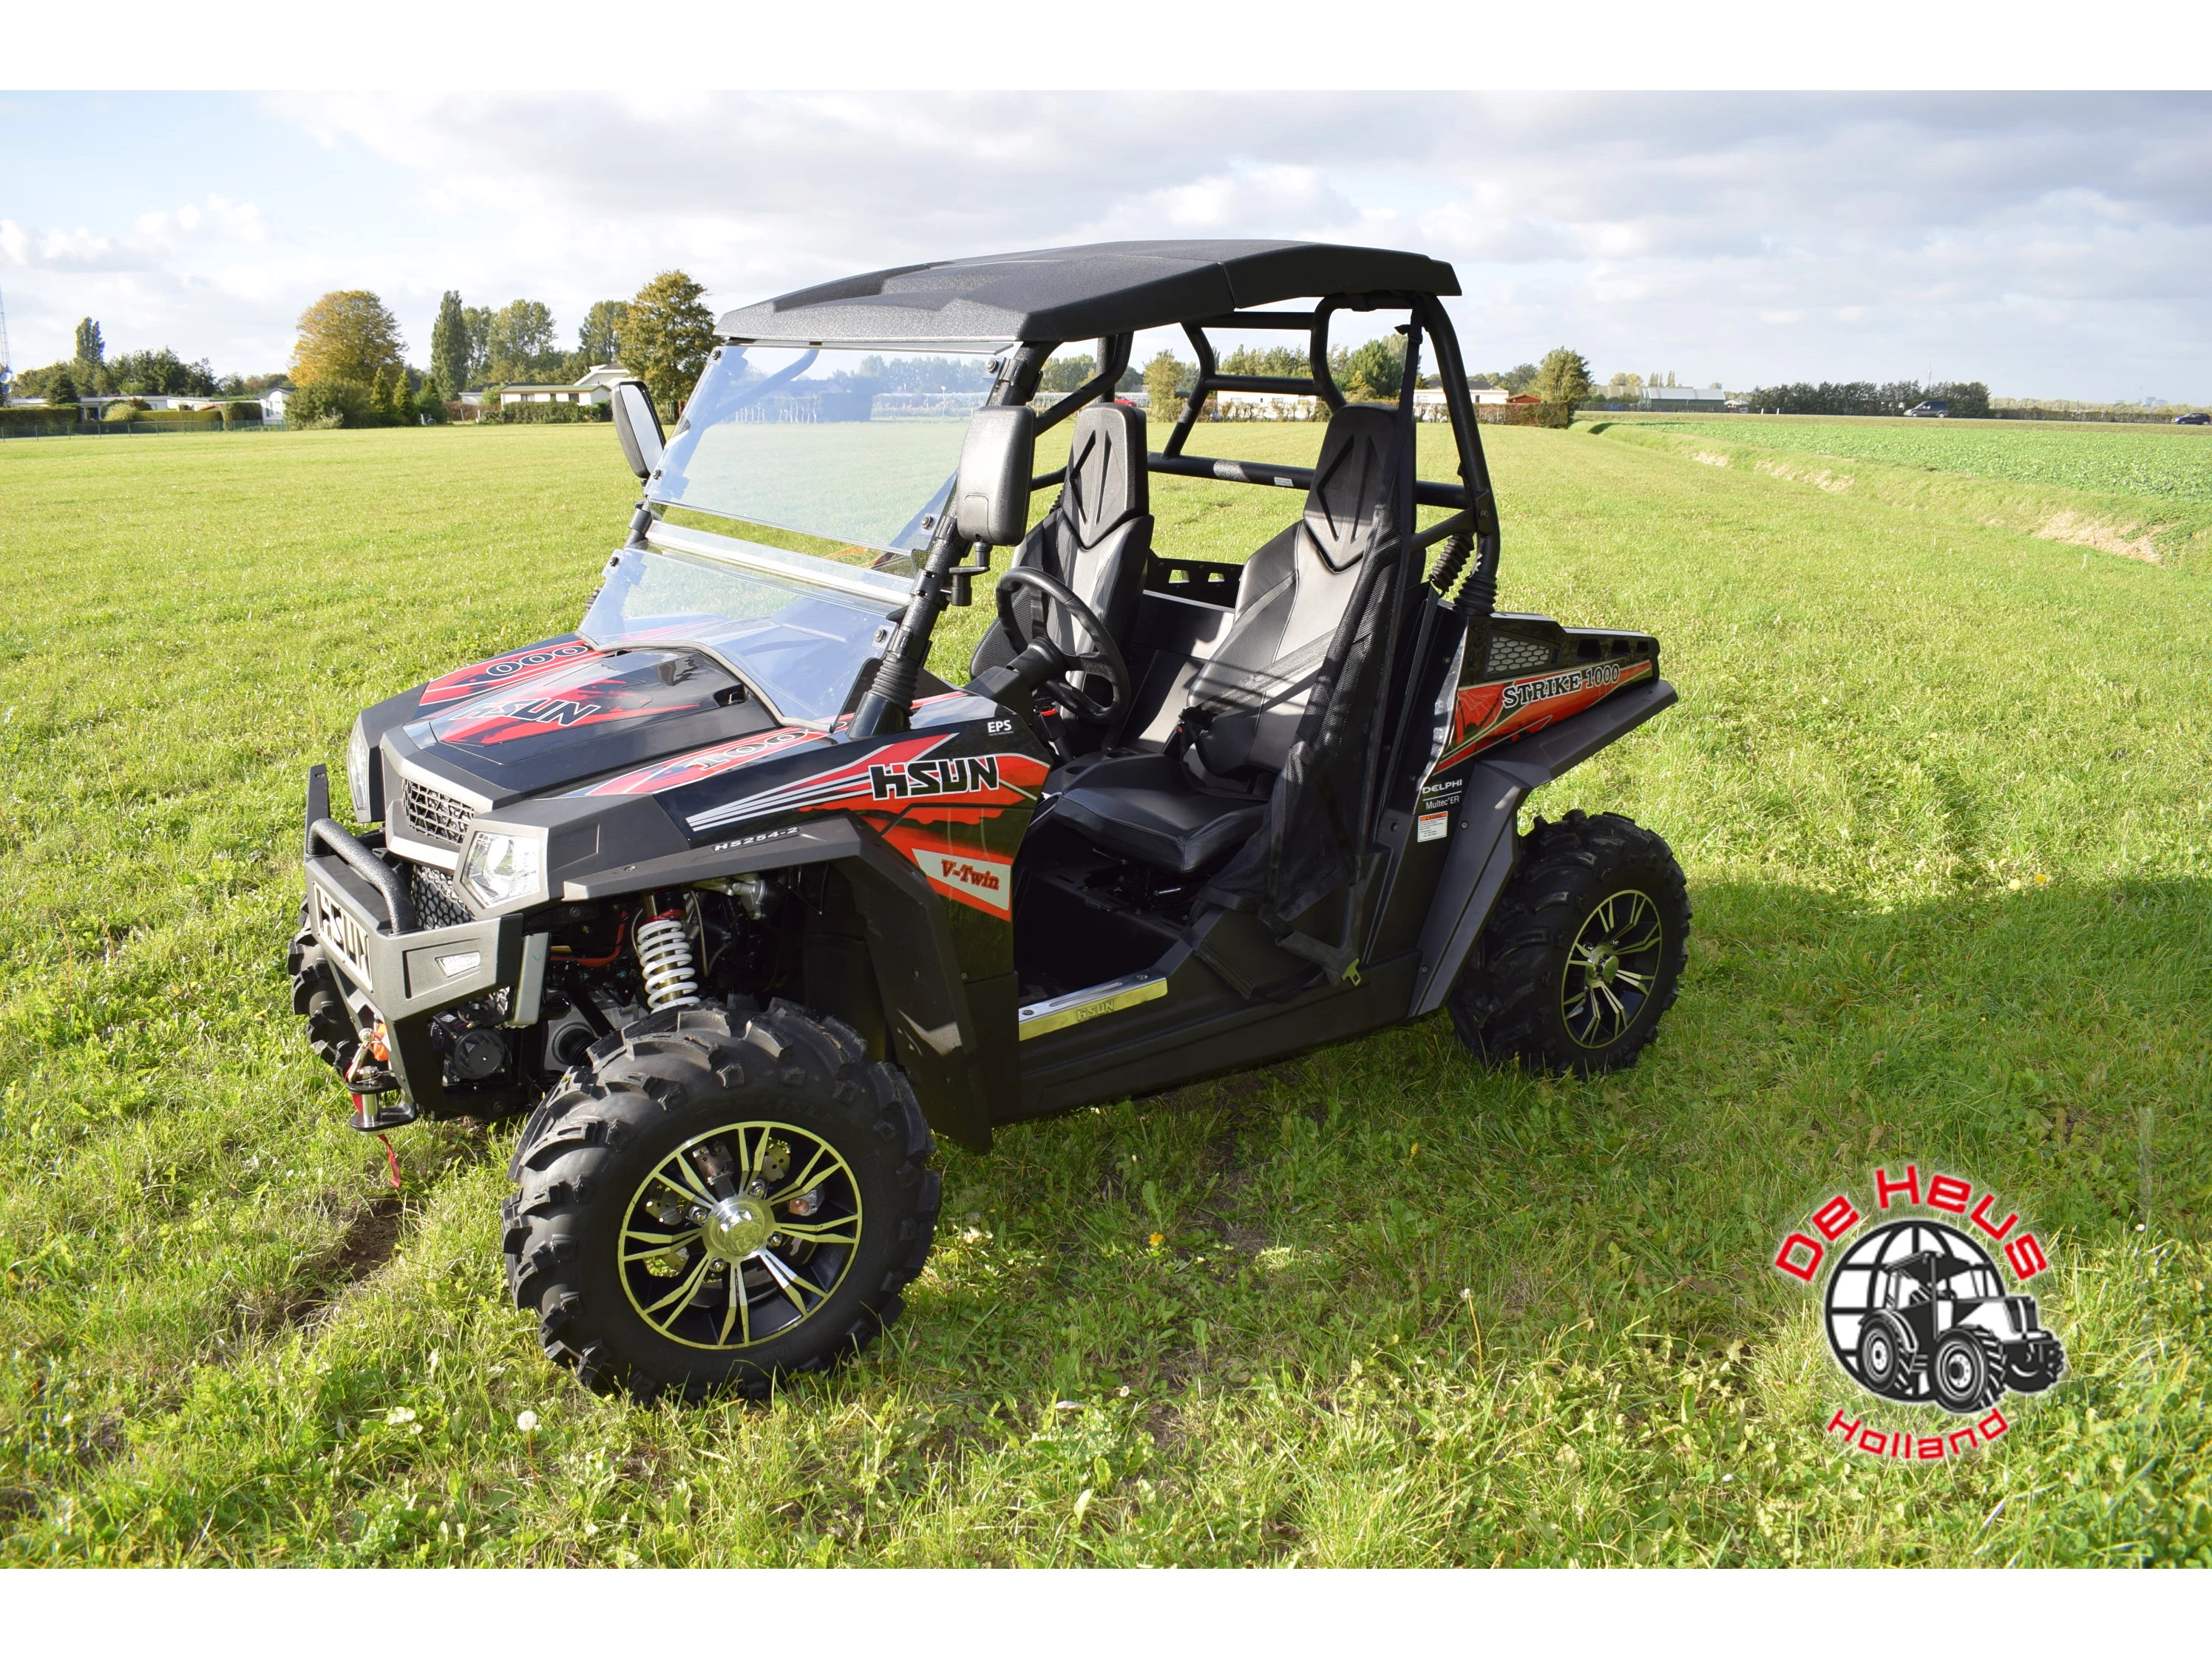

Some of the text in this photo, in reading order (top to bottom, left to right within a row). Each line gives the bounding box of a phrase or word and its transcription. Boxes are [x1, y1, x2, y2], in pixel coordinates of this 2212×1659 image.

[1502, 664, 1620, 709] STRIKE 1000
[987, 719, 1012, 733] EPS
[868, 754, 1000, 801] HSUN
[1422, 778, 1462, 794] DELPHI
[714, 827, 798, 852] HS254-2
[940, 858, 1000, 891] V-Twin
[1076, 999, 1116, 1022] HSUN
